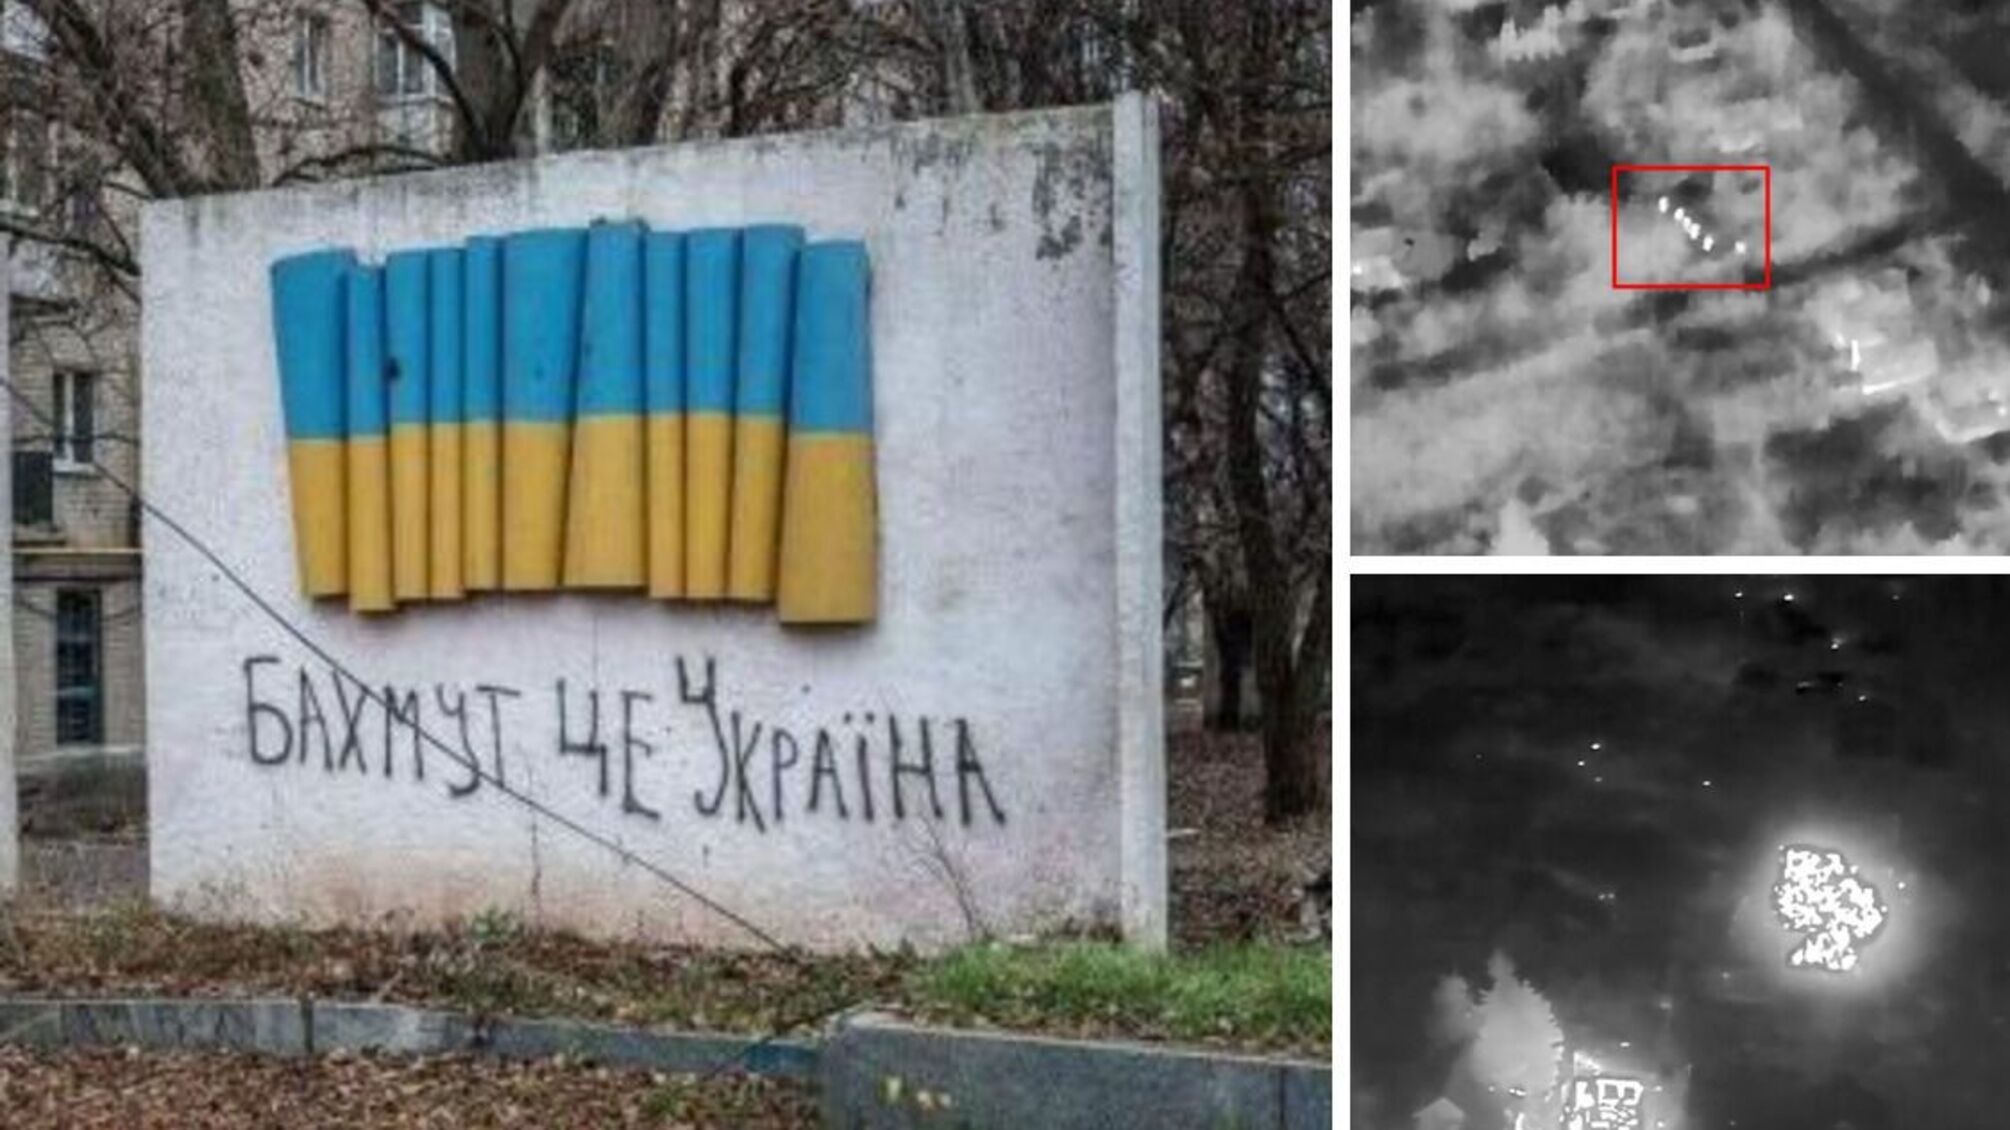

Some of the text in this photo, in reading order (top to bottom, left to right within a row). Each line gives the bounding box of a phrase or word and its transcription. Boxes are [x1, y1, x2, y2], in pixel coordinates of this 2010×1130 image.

[243, 655, 1006, 833] БАХМУТ ЦЕ УКРАЇНА
